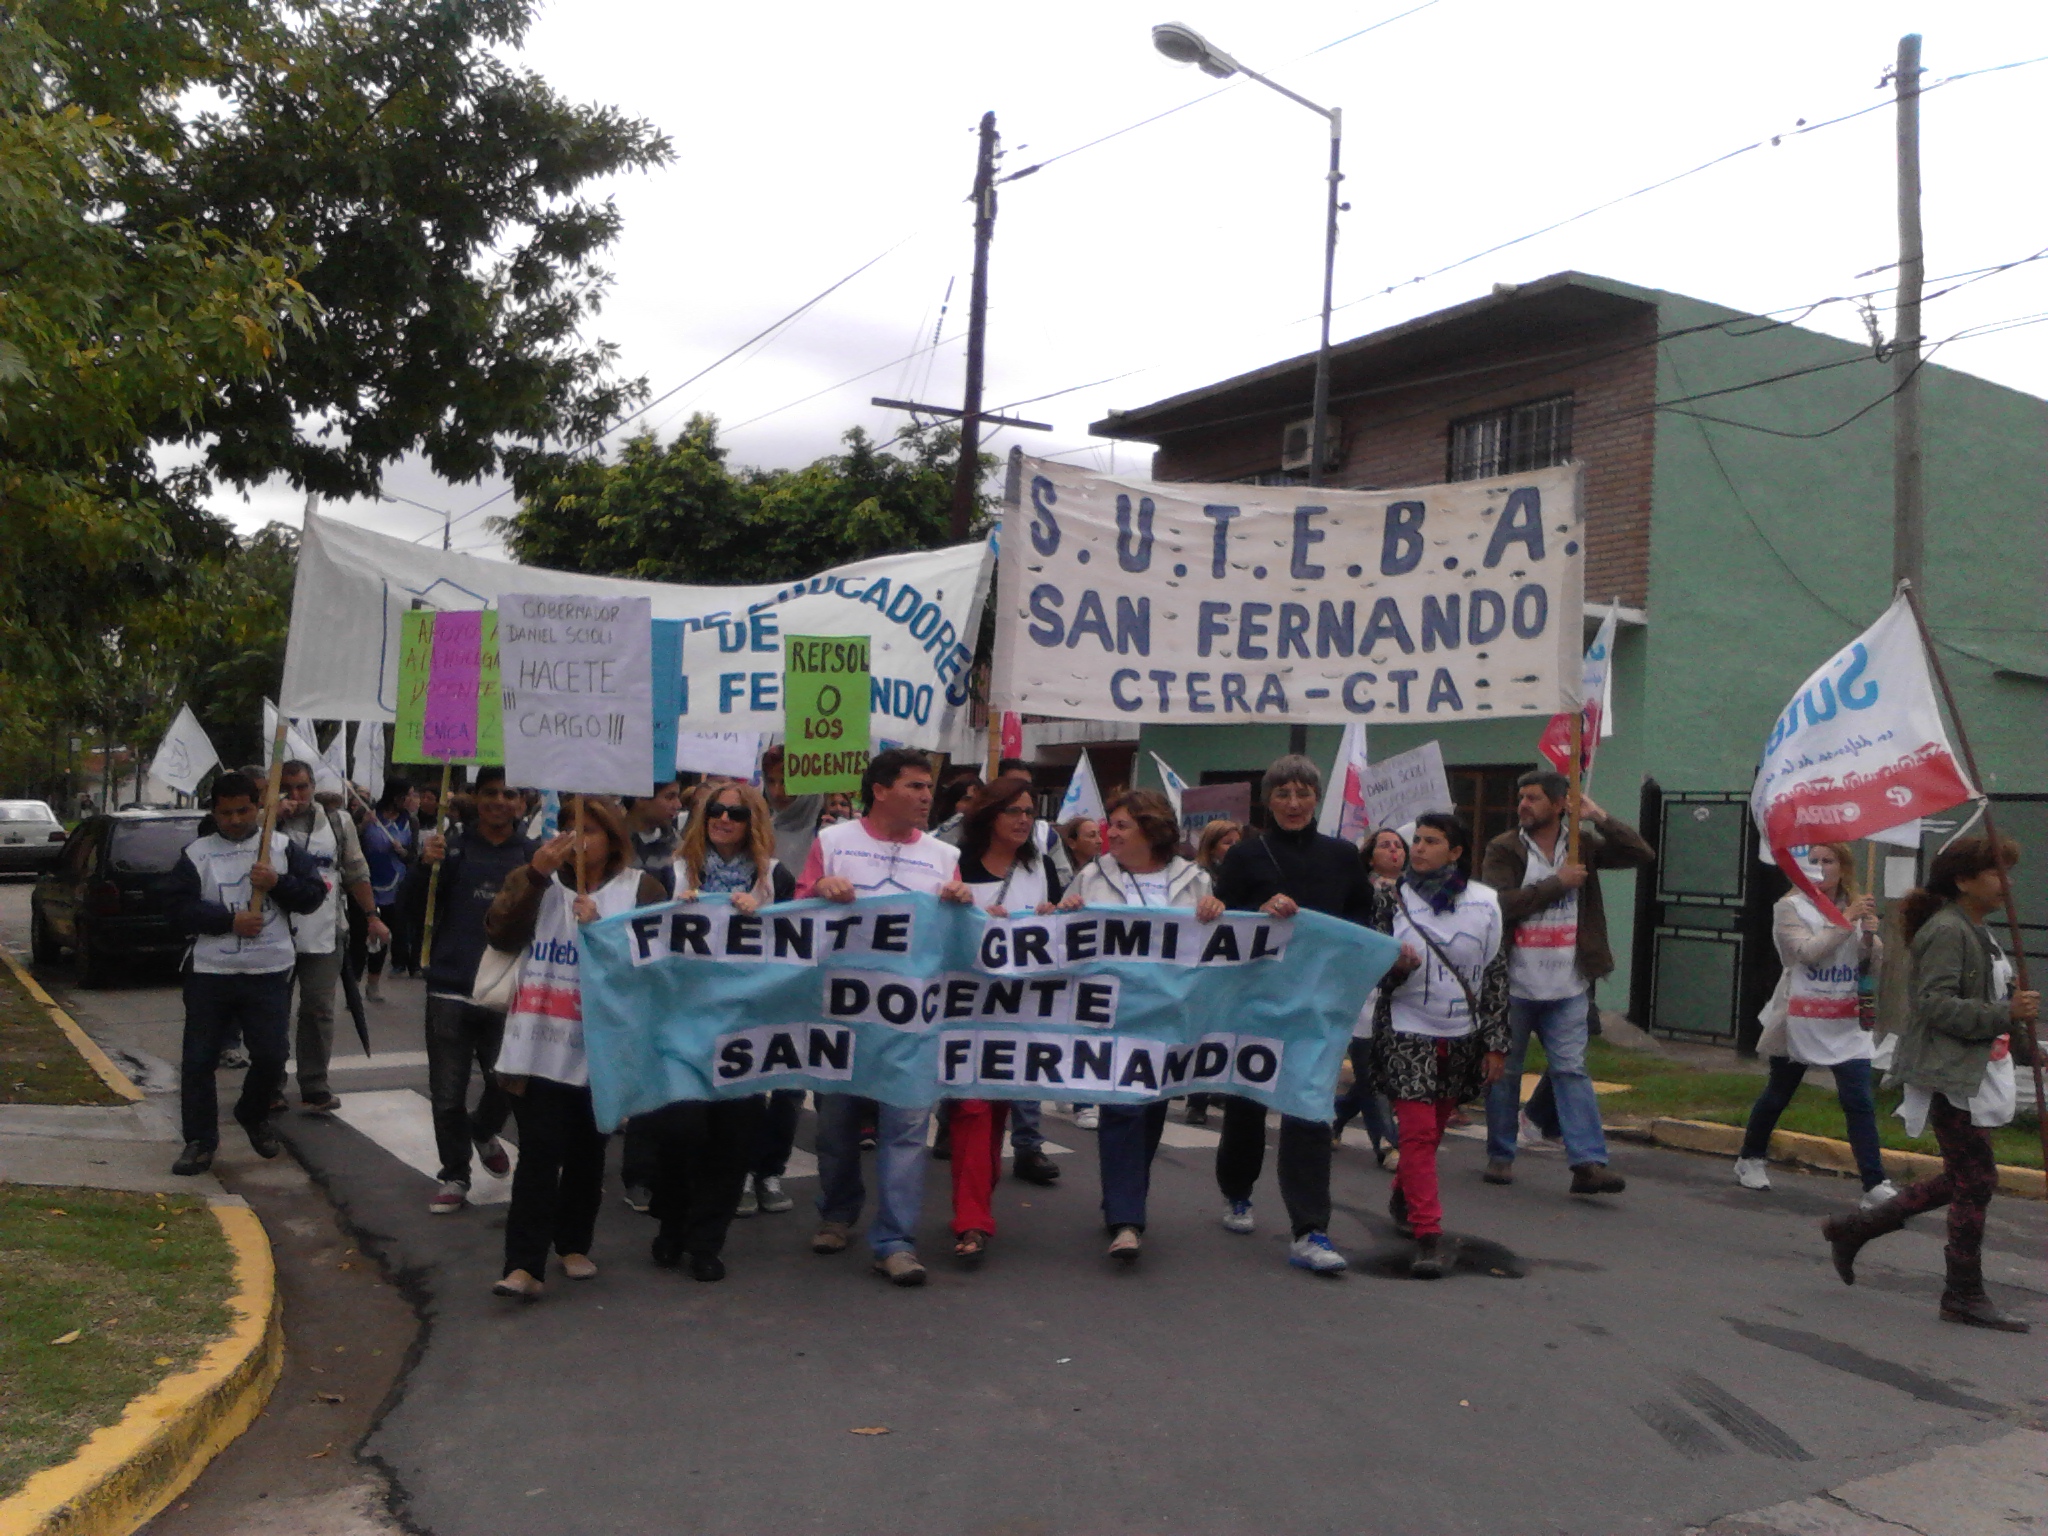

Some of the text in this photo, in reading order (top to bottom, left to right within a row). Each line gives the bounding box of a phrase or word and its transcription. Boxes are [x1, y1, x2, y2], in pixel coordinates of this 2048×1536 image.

[506, 623, 613, 645] DANIEL SCIOLI
[719, 613, 780, 653] DE
[1027, 583, 1549, 660] SAN FERNANDO
[519, 658, 617, 694] HACETE
[791, 642, 870, 674] REPSOL
[719, 672, 934, 726] FENDO
[816, 684, 841, 716] O
[804, 718, 843, 740] LOS
[788, 750, 870, 778] DOCENTES
[631, 911, 912, 960] FRENTE
[980, 916, 1282, 969] GREMIAL
[828, 976, 1115, 1026] DOCENTE
[718, 1028, 1279, 1091] SAN FERNANDO
